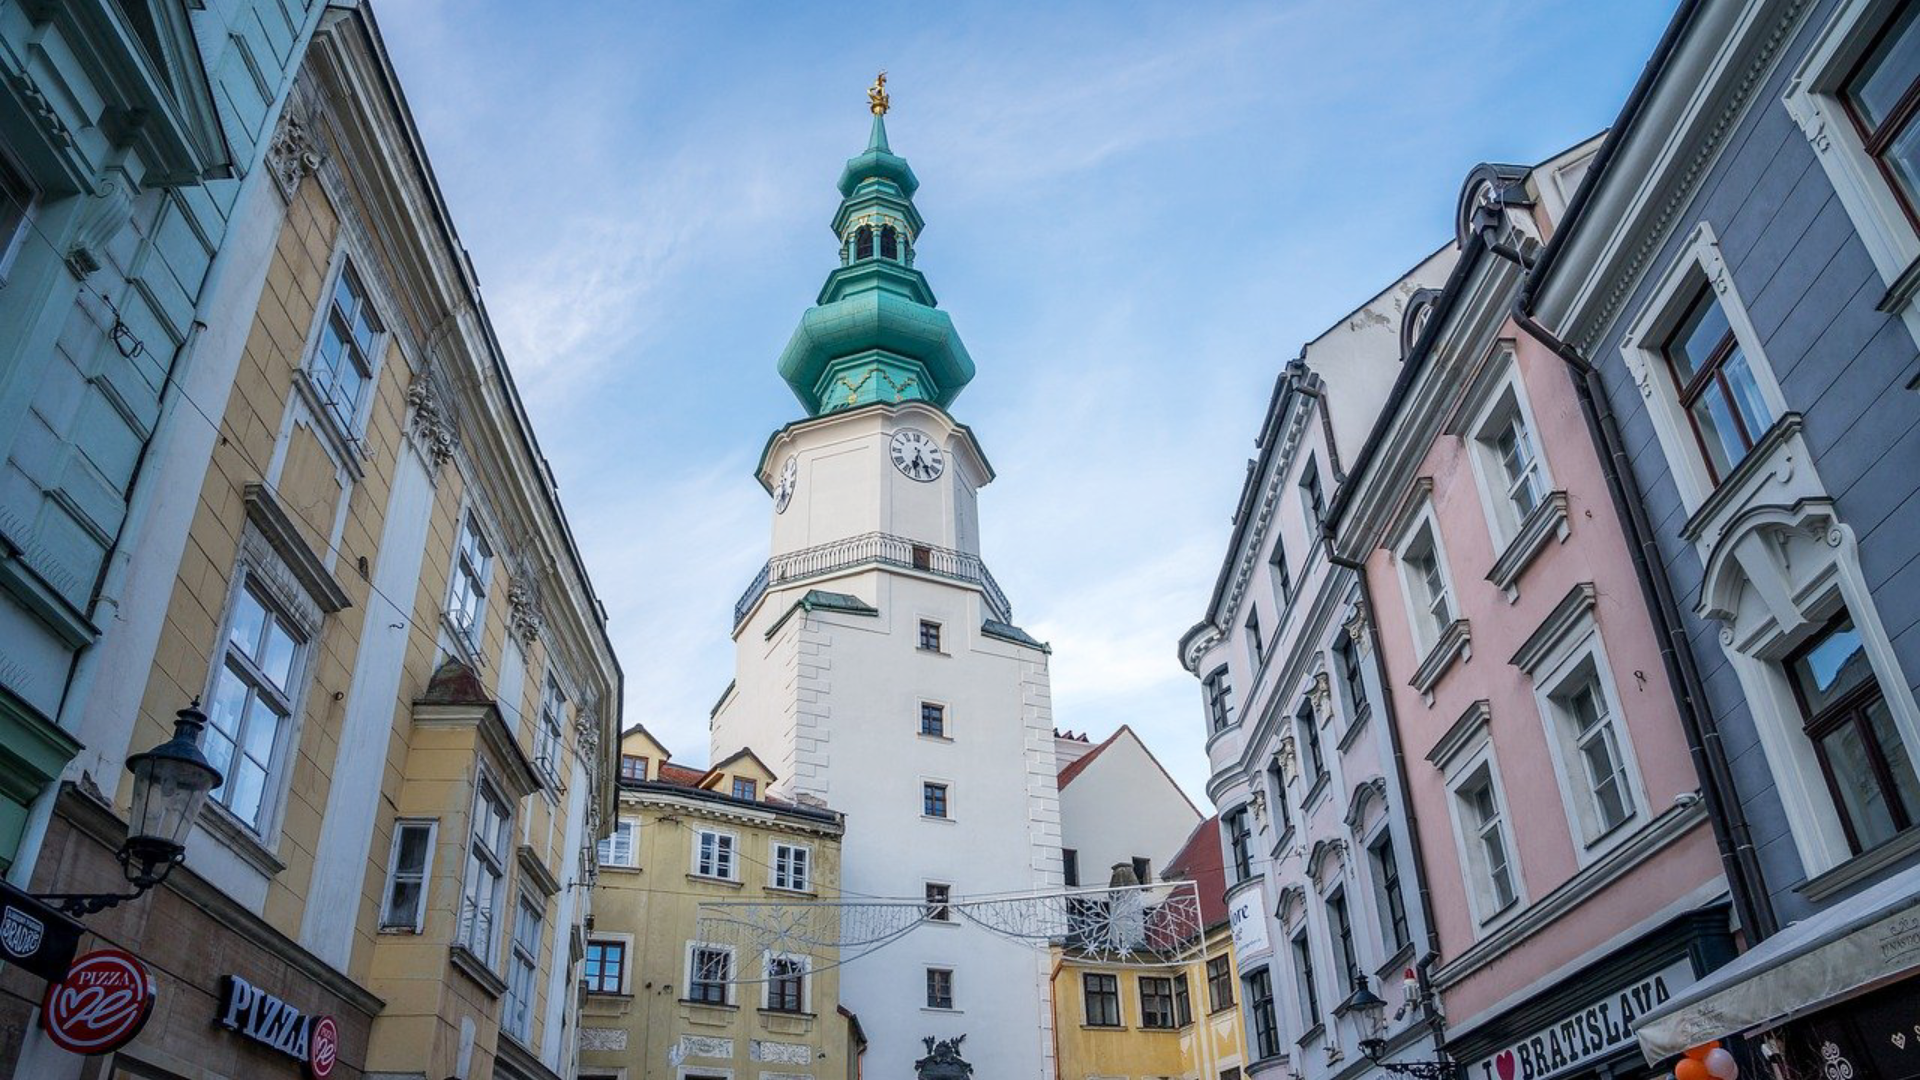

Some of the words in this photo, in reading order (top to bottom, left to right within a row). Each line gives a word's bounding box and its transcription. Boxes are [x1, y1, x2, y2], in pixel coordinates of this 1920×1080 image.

[79, 971, 129, 985] PIZZA
[223, 974, 309, 1062] PIZZA
[1516, 975, 1671, 1080] BRATISLAVA
